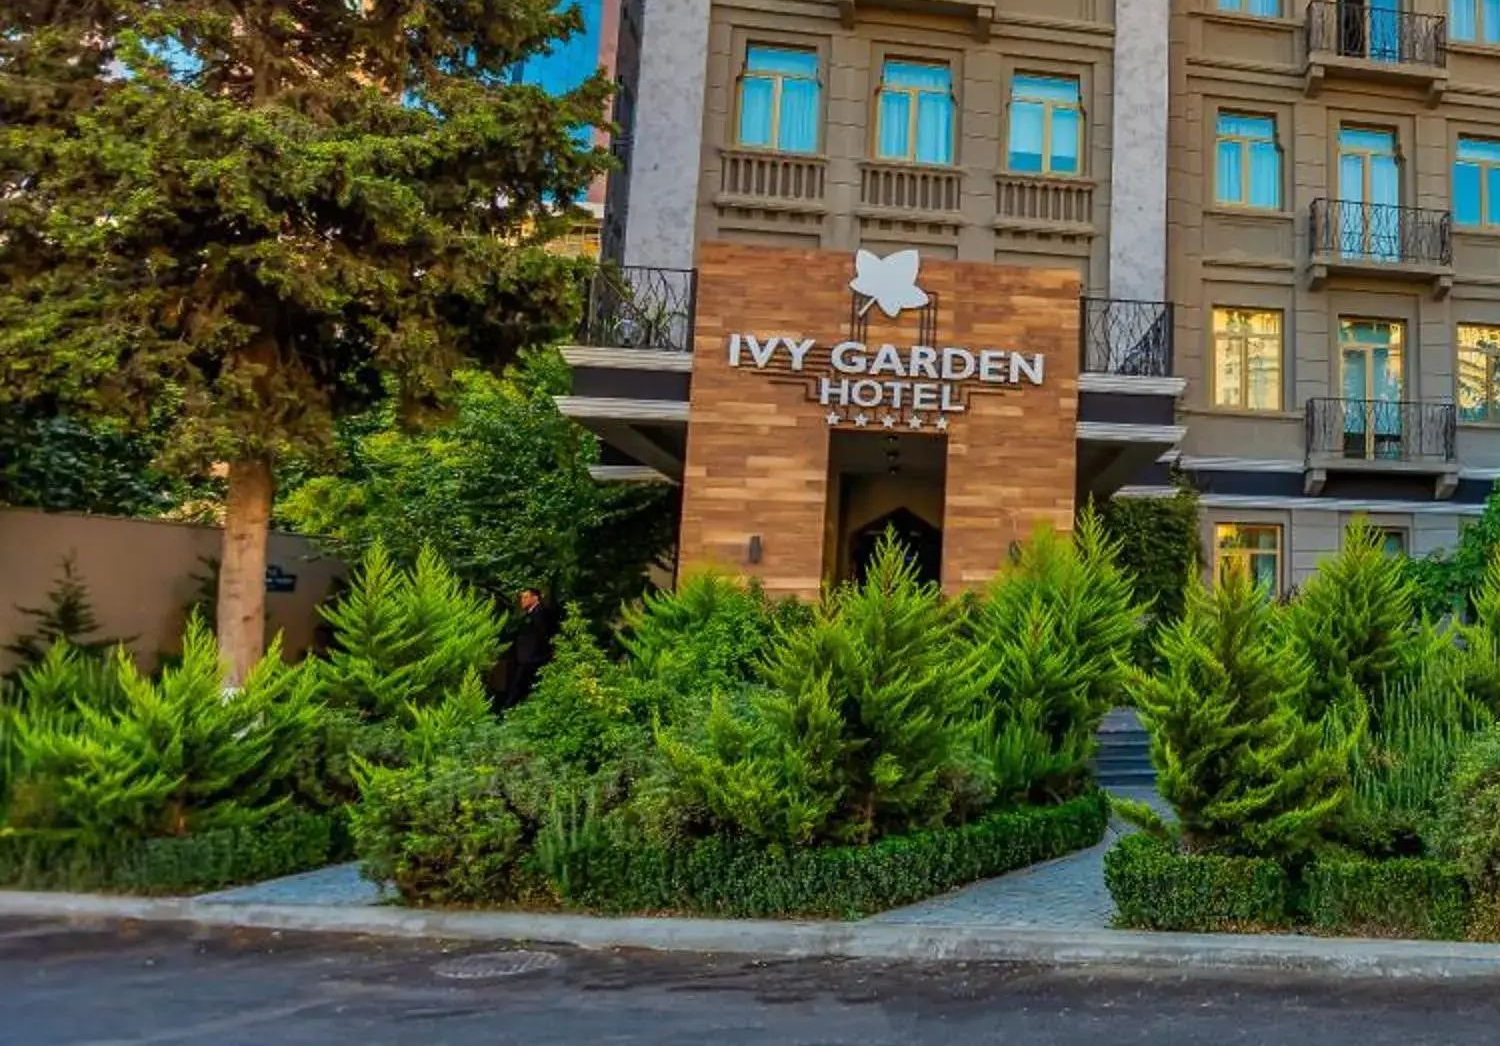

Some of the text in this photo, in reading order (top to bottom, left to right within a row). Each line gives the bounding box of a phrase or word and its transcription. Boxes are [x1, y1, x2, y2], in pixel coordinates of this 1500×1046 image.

[728, 333, 1044, 385] IVY GARDEN
[820, 377, 965, 411] HOTEL
